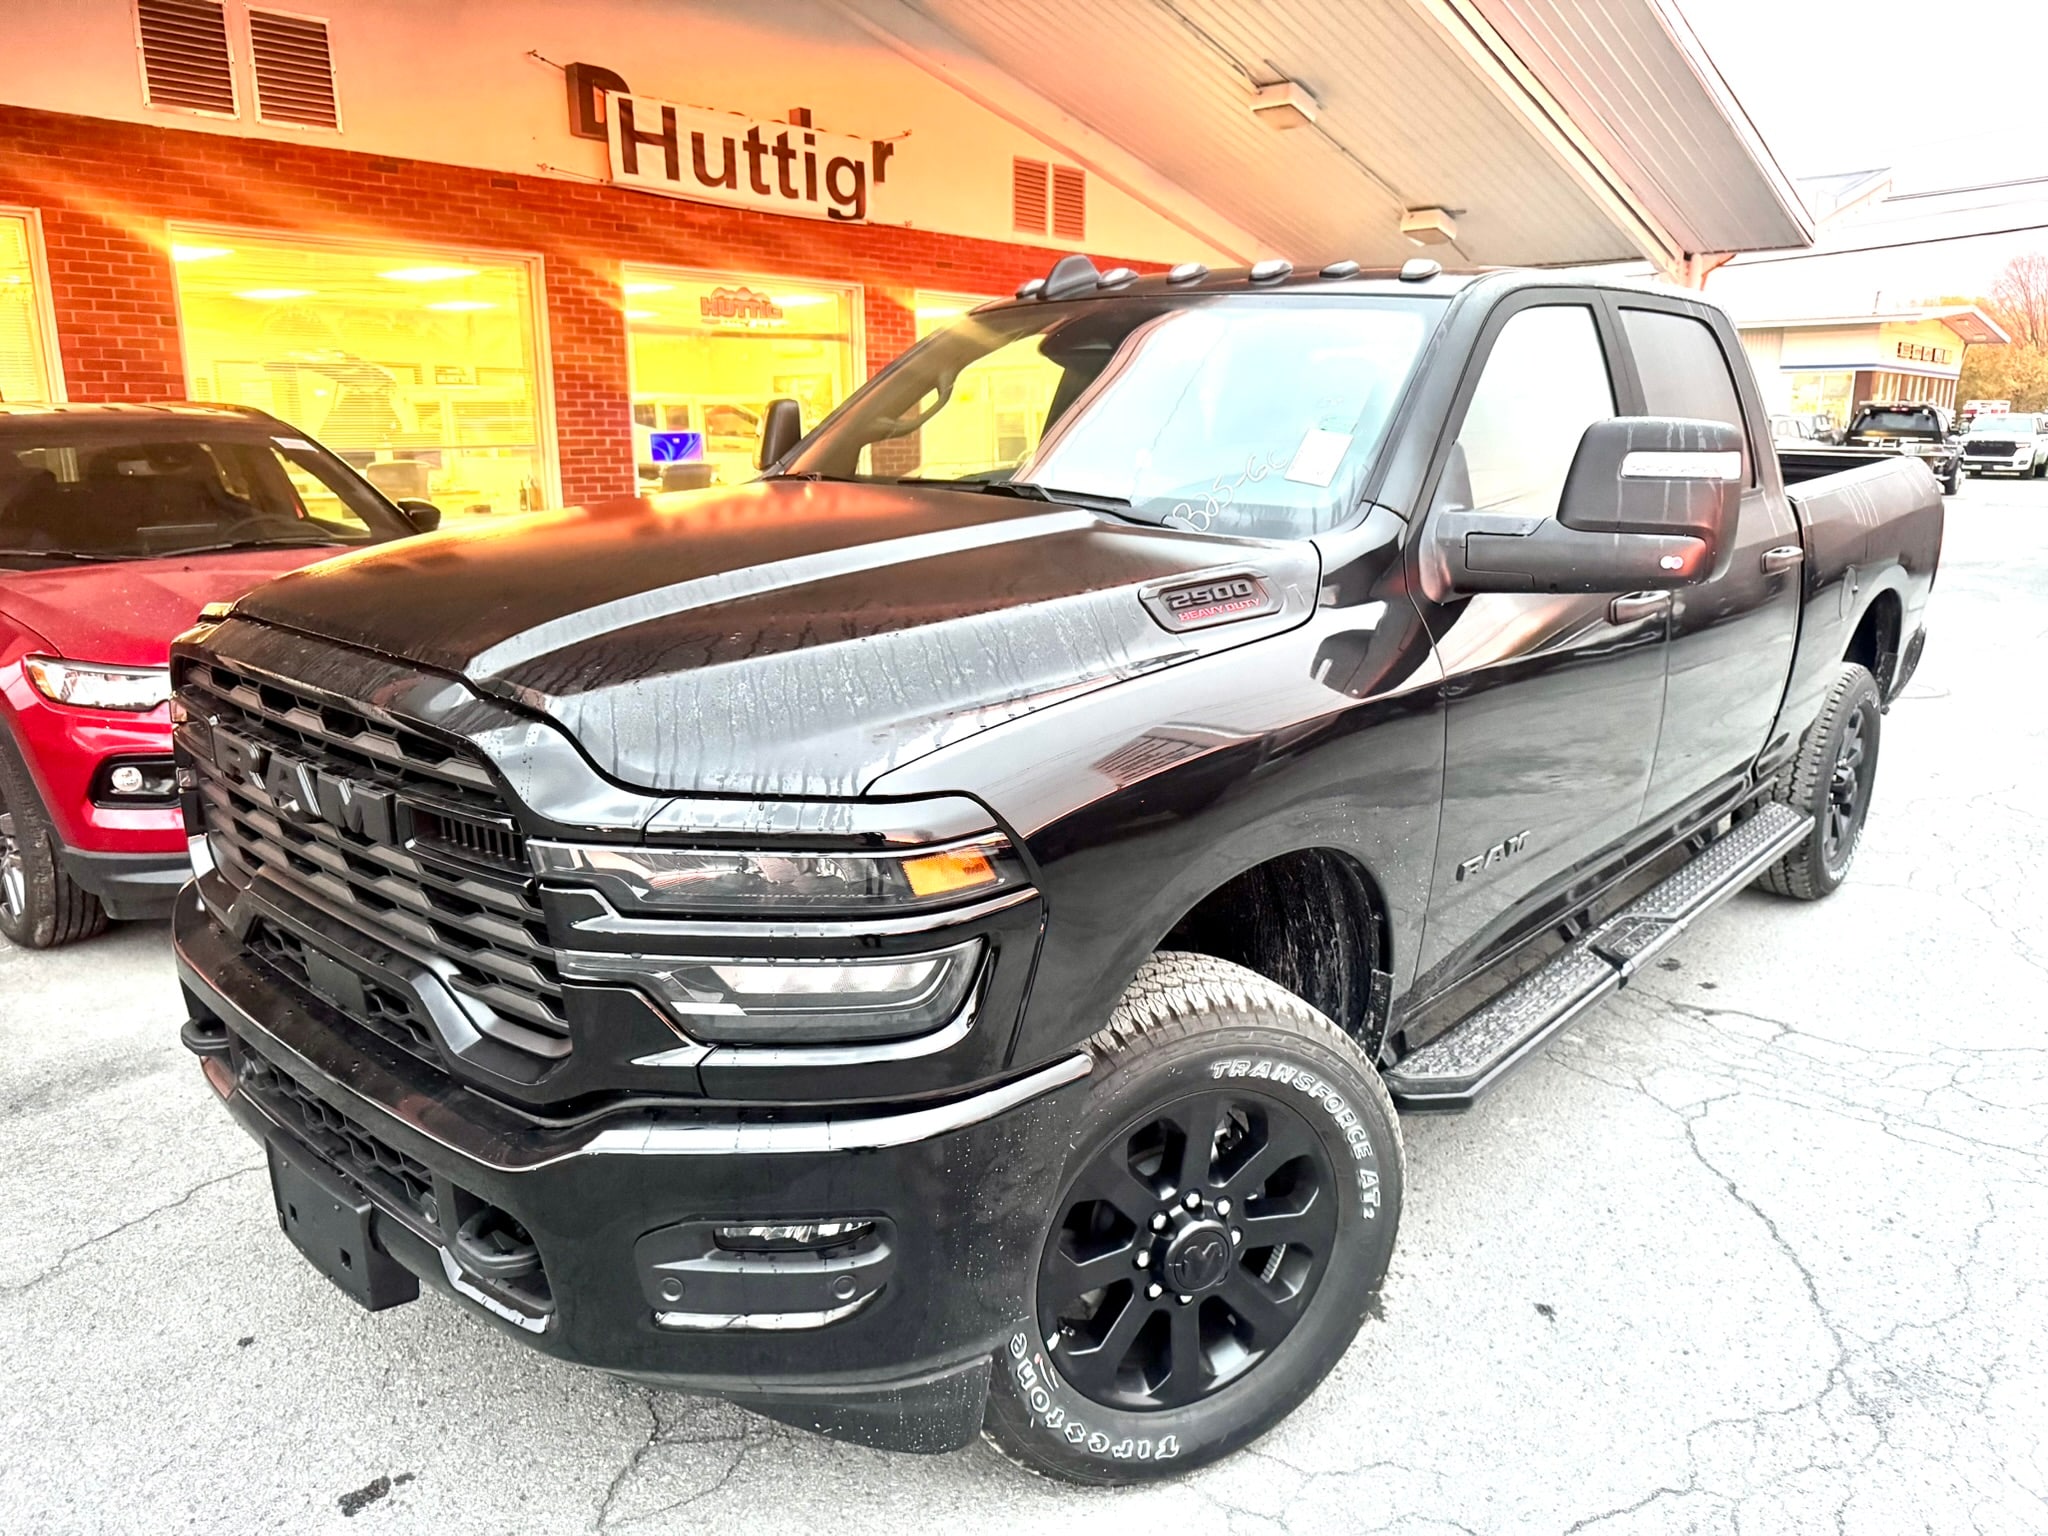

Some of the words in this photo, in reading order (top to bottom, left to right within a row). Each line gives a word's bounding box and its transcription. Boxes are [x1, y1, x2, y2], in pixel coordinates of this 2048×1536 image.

[617, 97, 866, 221] Huttig
[700, 296, 783, 319] HUTTIG
[1168, 582, 1254, 611] 2500
[1178, 604, 1224, 622] HEAVY
[1225, 598, 1260, 613] DUTY
[213, 722, 397, 846] RAM
[1456, 830, 1531, 882] RAM
[1211, 1059, 1374, 1161] TRANSFORCE
